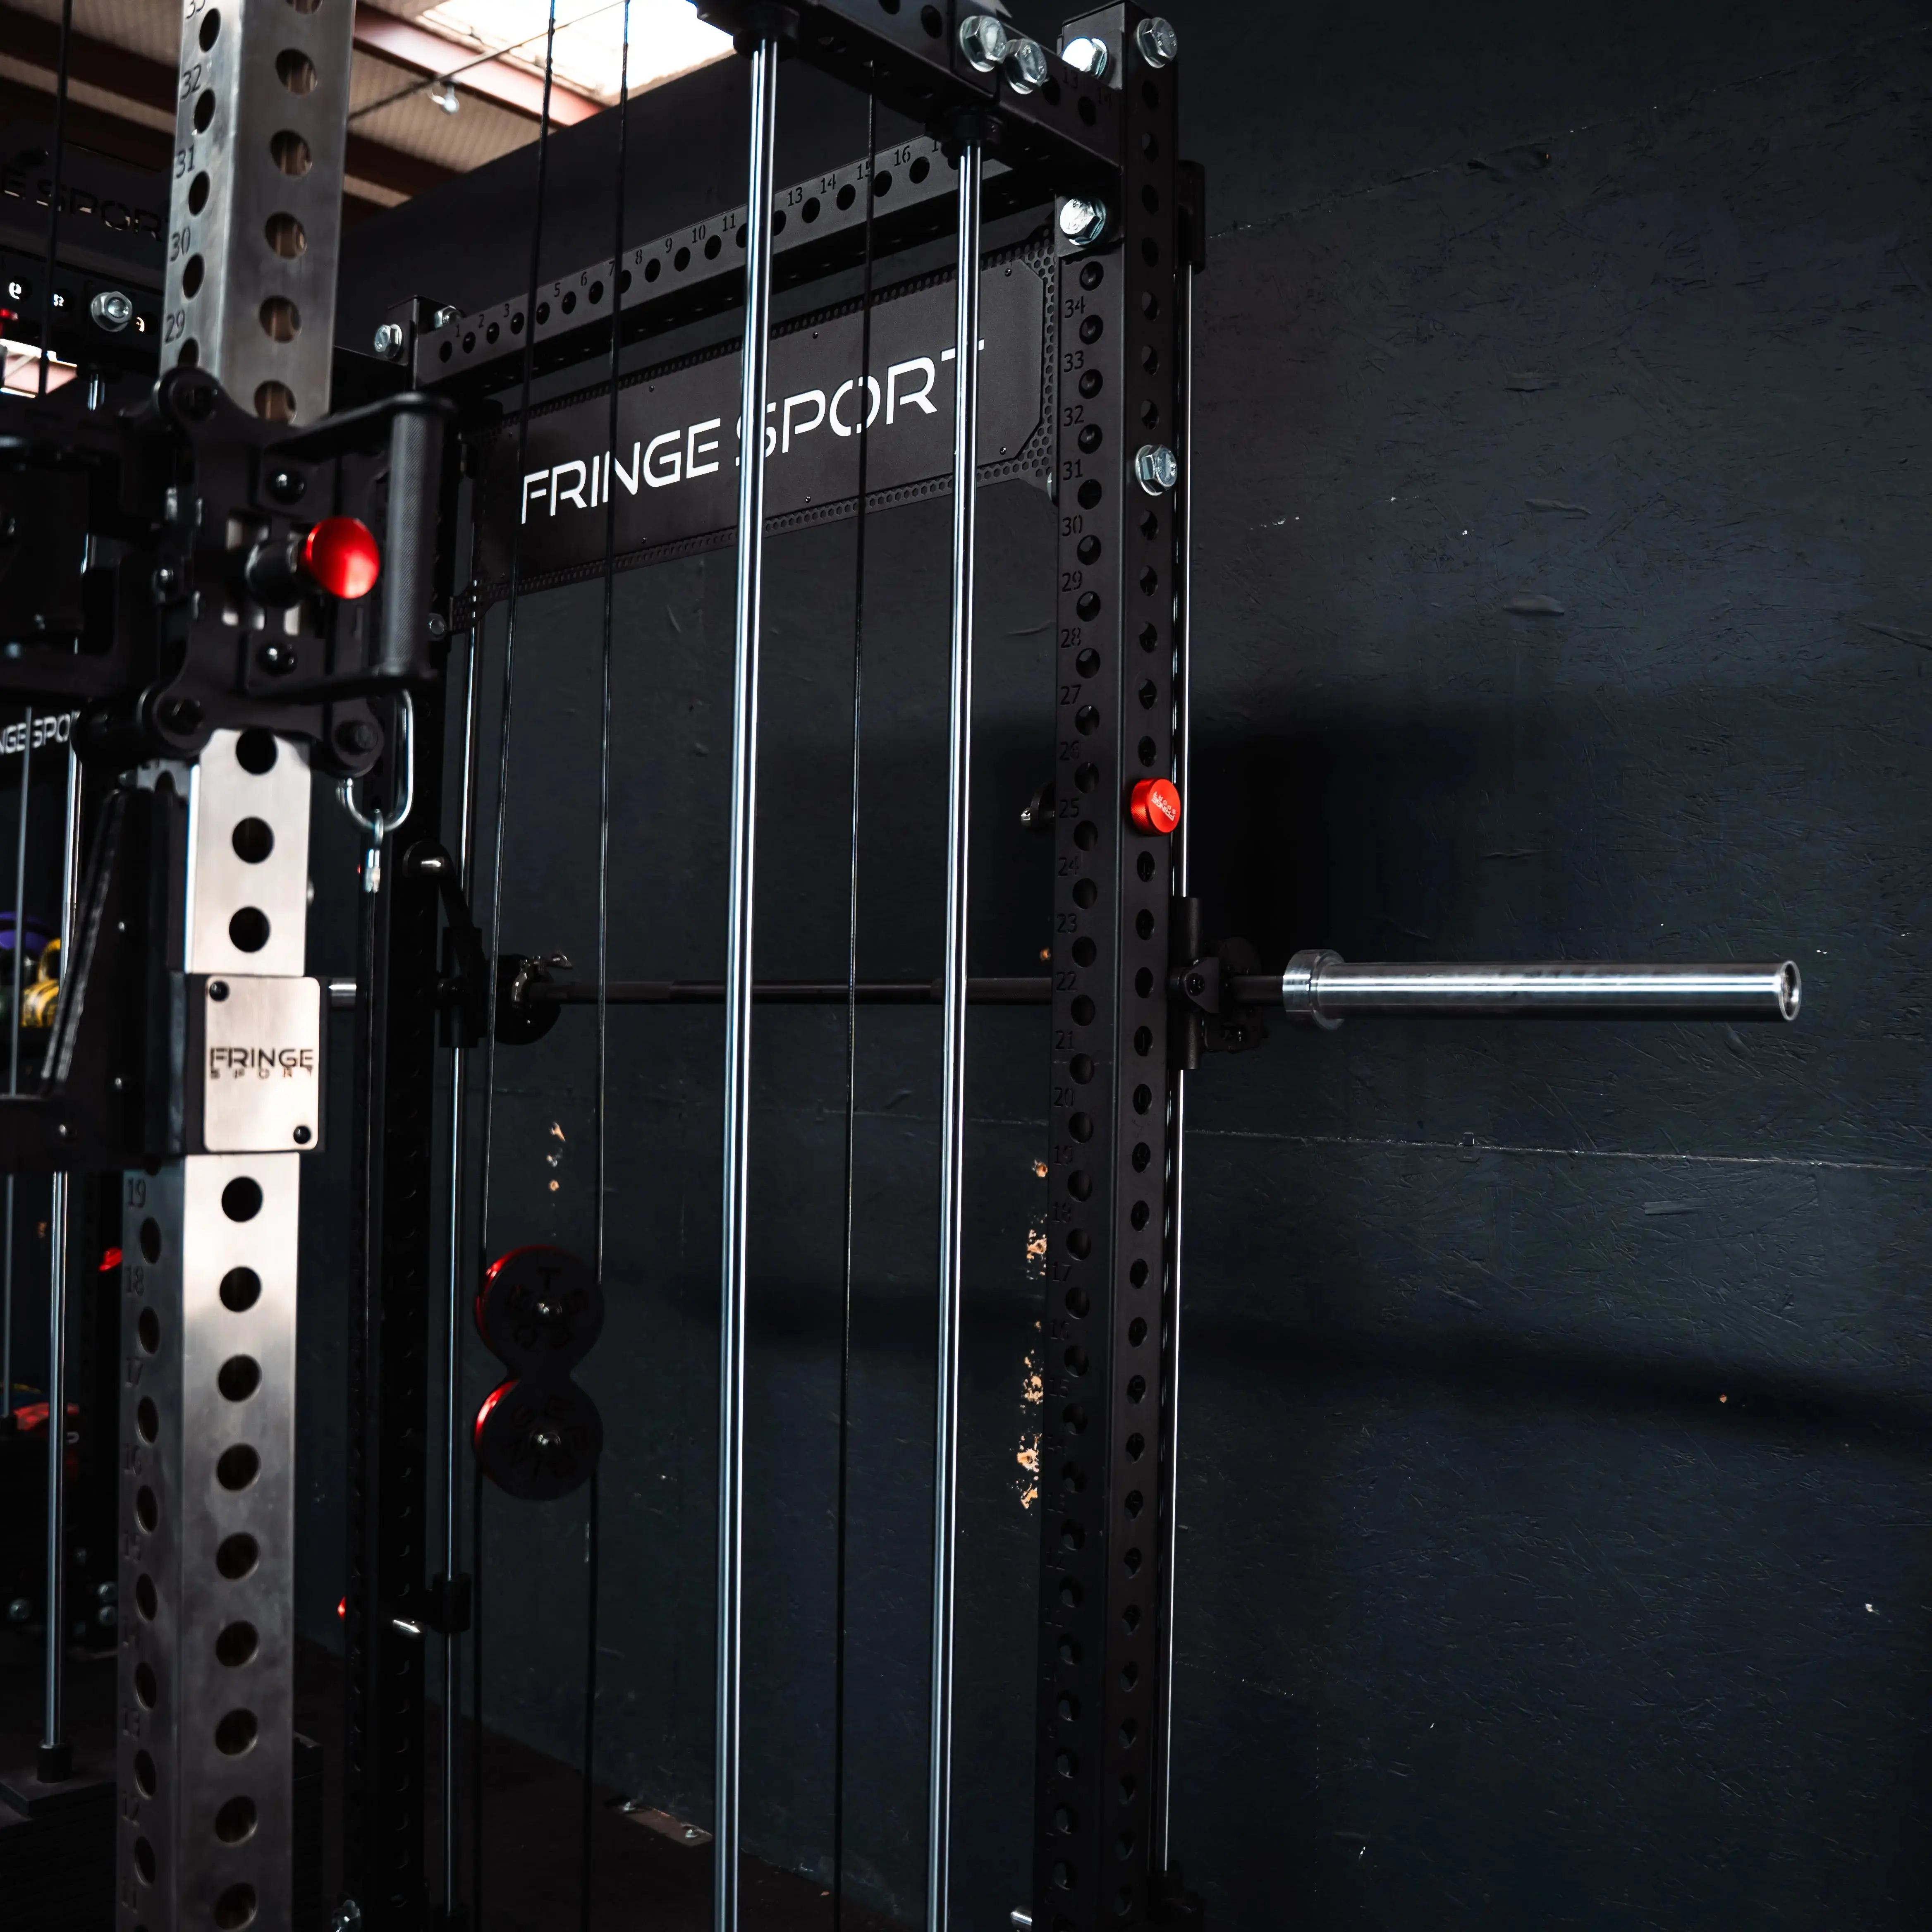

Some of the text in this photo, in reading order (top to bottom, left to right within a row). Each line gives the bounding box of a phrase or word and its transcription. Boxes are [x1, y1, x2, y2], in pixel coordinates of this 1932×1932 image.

[181, 64, 201, 99] 32
[176, 144, 194, 179] 31
[36, 178, 165, 243] SPOR
[170, 227, 191, 262] 30
[478, 314, 484, 328] 2
[503, 303, 509, 318] 3
[554, 282, 560, 297] 5
[581, 271, 587, 286] 6
[609, 260, 615, 276] 7
[636, 249, 642, 264] 8
[666, 237, 672, 253] 9
[692, 225, 705, 243] 10
[723, 213, 736, 232] 11
[788, 187, 802, 206] 13
[820, 174, 836, 194] 14
[894, 145, 911, 167] 16
[1064, 295, 1086, 318] 34
[165, 309, 185, 344] 29
[1064, 350, 1084, 373] 33
[1063, 405, 1084, 427] 32
[521, 417, 721, 524] FRINGE
[1063, 459, 1083, 481] 31
[1062, 514, 1083, 537] 30
[1062, 570, 1083, 592] 29
[1061, 627, 1081, 648] 28
[1060, 684, 1081, 705] 27
[1059, 740, 1079, 761] 26
[1059, 797, 1080, 818] 25
[1058, 856, 1079, 876] 24
[1057, 913, 1078, 933] 23
[1055, 971, 1077, 992] 22
[1054, 1030, 1075, 1051] 21
[210, 1047, 313, 1068] FRINGE
[210, 1066, 313, 1079] SPORT
[1053, 1087, 1074, 1108] 20
[128, 1177, 146, 1208] 19
[125, 1264, 144, 1297] 18
[1052, 1261, 1072, 1282] 17
[124, 1355, 143, 1387] 17
